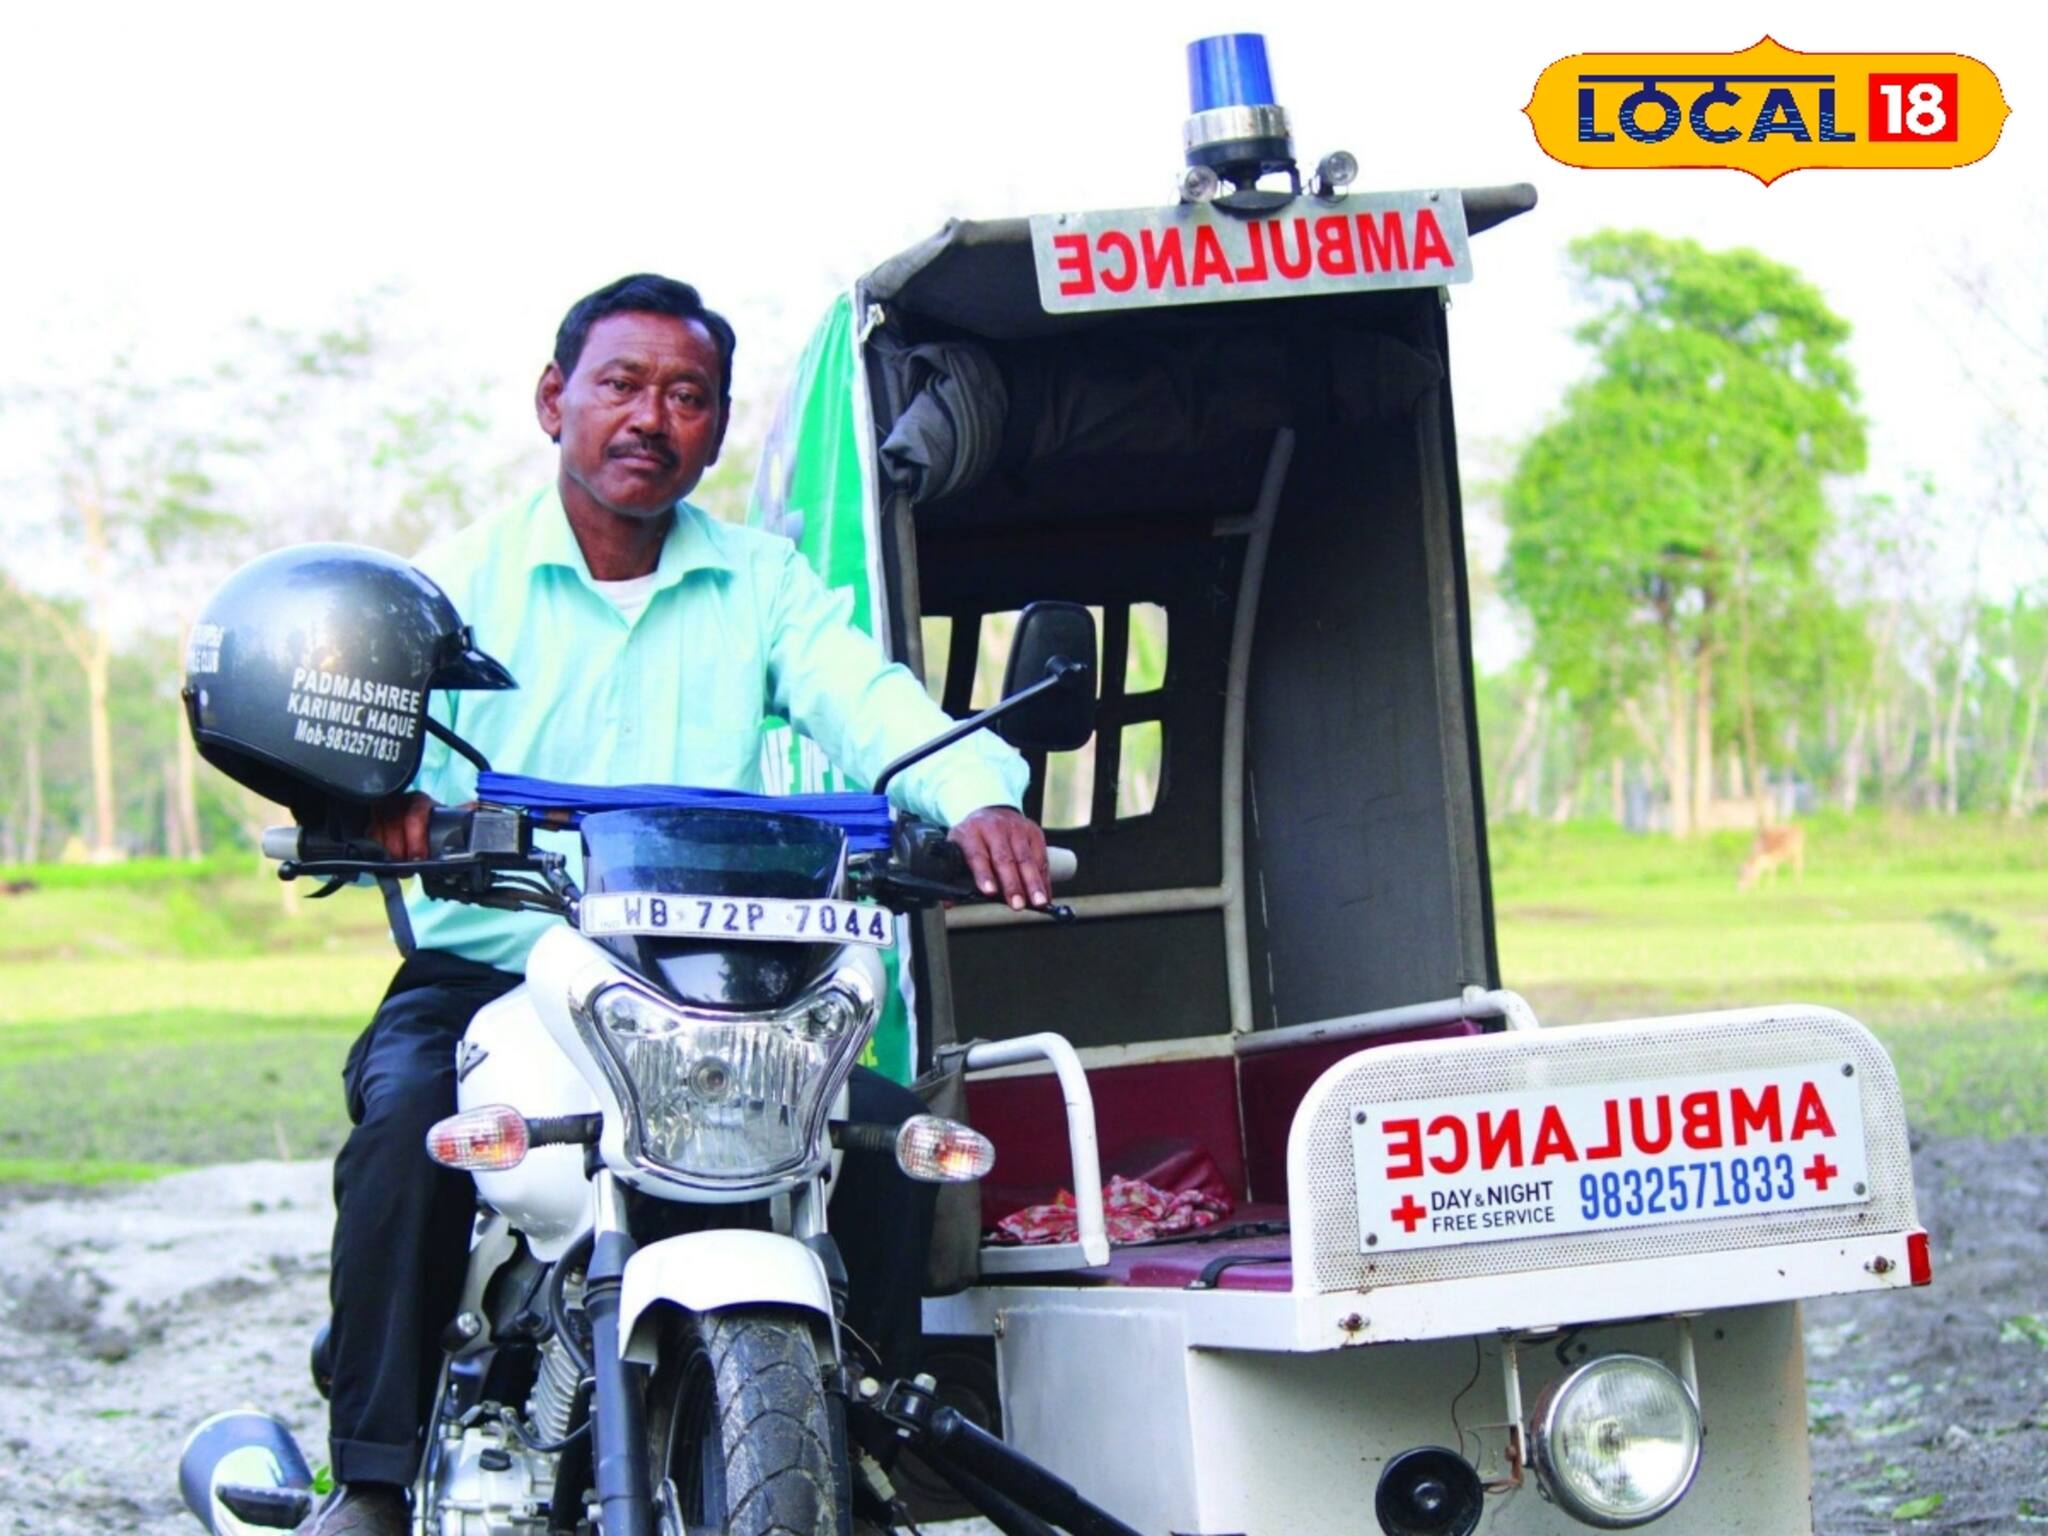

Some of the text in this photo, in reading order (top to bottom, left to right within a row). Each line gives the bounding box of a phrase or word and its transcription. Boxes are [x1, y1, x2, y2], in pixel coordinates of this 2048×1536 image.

[291, 667, 421, 714] PADMASHREE
[287, 692, 417, 739] KARIMUL HAQUE
[624, 898, 886, 940] WB 72P 7044
[1580, 1153, 1795, 1221] 9832571833
[1432, 1205, 1556, 1233] FREE SERVICE
